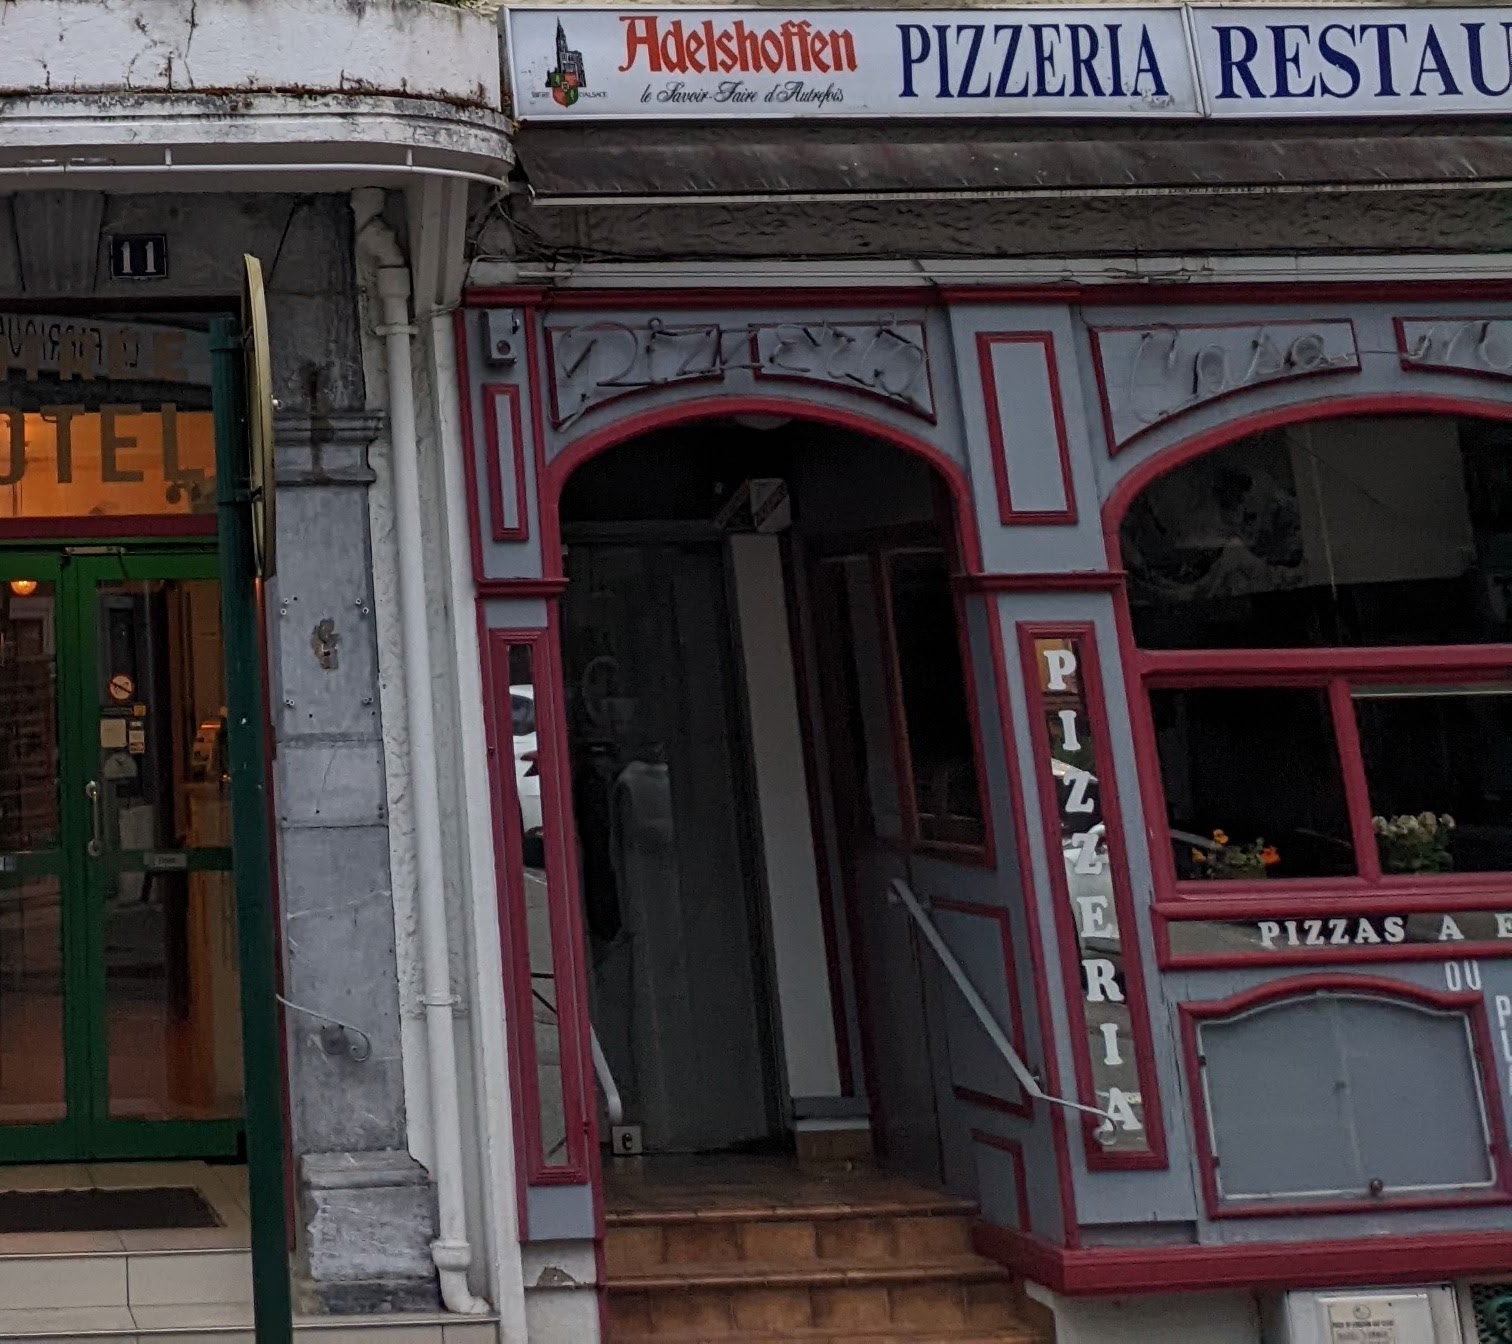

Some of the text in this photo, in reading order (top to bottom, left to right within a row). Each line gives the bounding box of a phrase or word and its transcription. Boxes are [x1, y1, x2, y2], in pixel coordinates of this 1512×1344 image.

[618, 16, 858, 74] Adelshoffen
[896, 22, 1512, 100] PIZZERIA RESTAU
[121, 241, 157, 273] 11
[1044, 650, 1142, 1130] PIZZERIA
[1257, 916, 1406, 949] PIZZAS
[1438, 914, 1465, 941] A
[1444, 960, 1481, 991] OU
